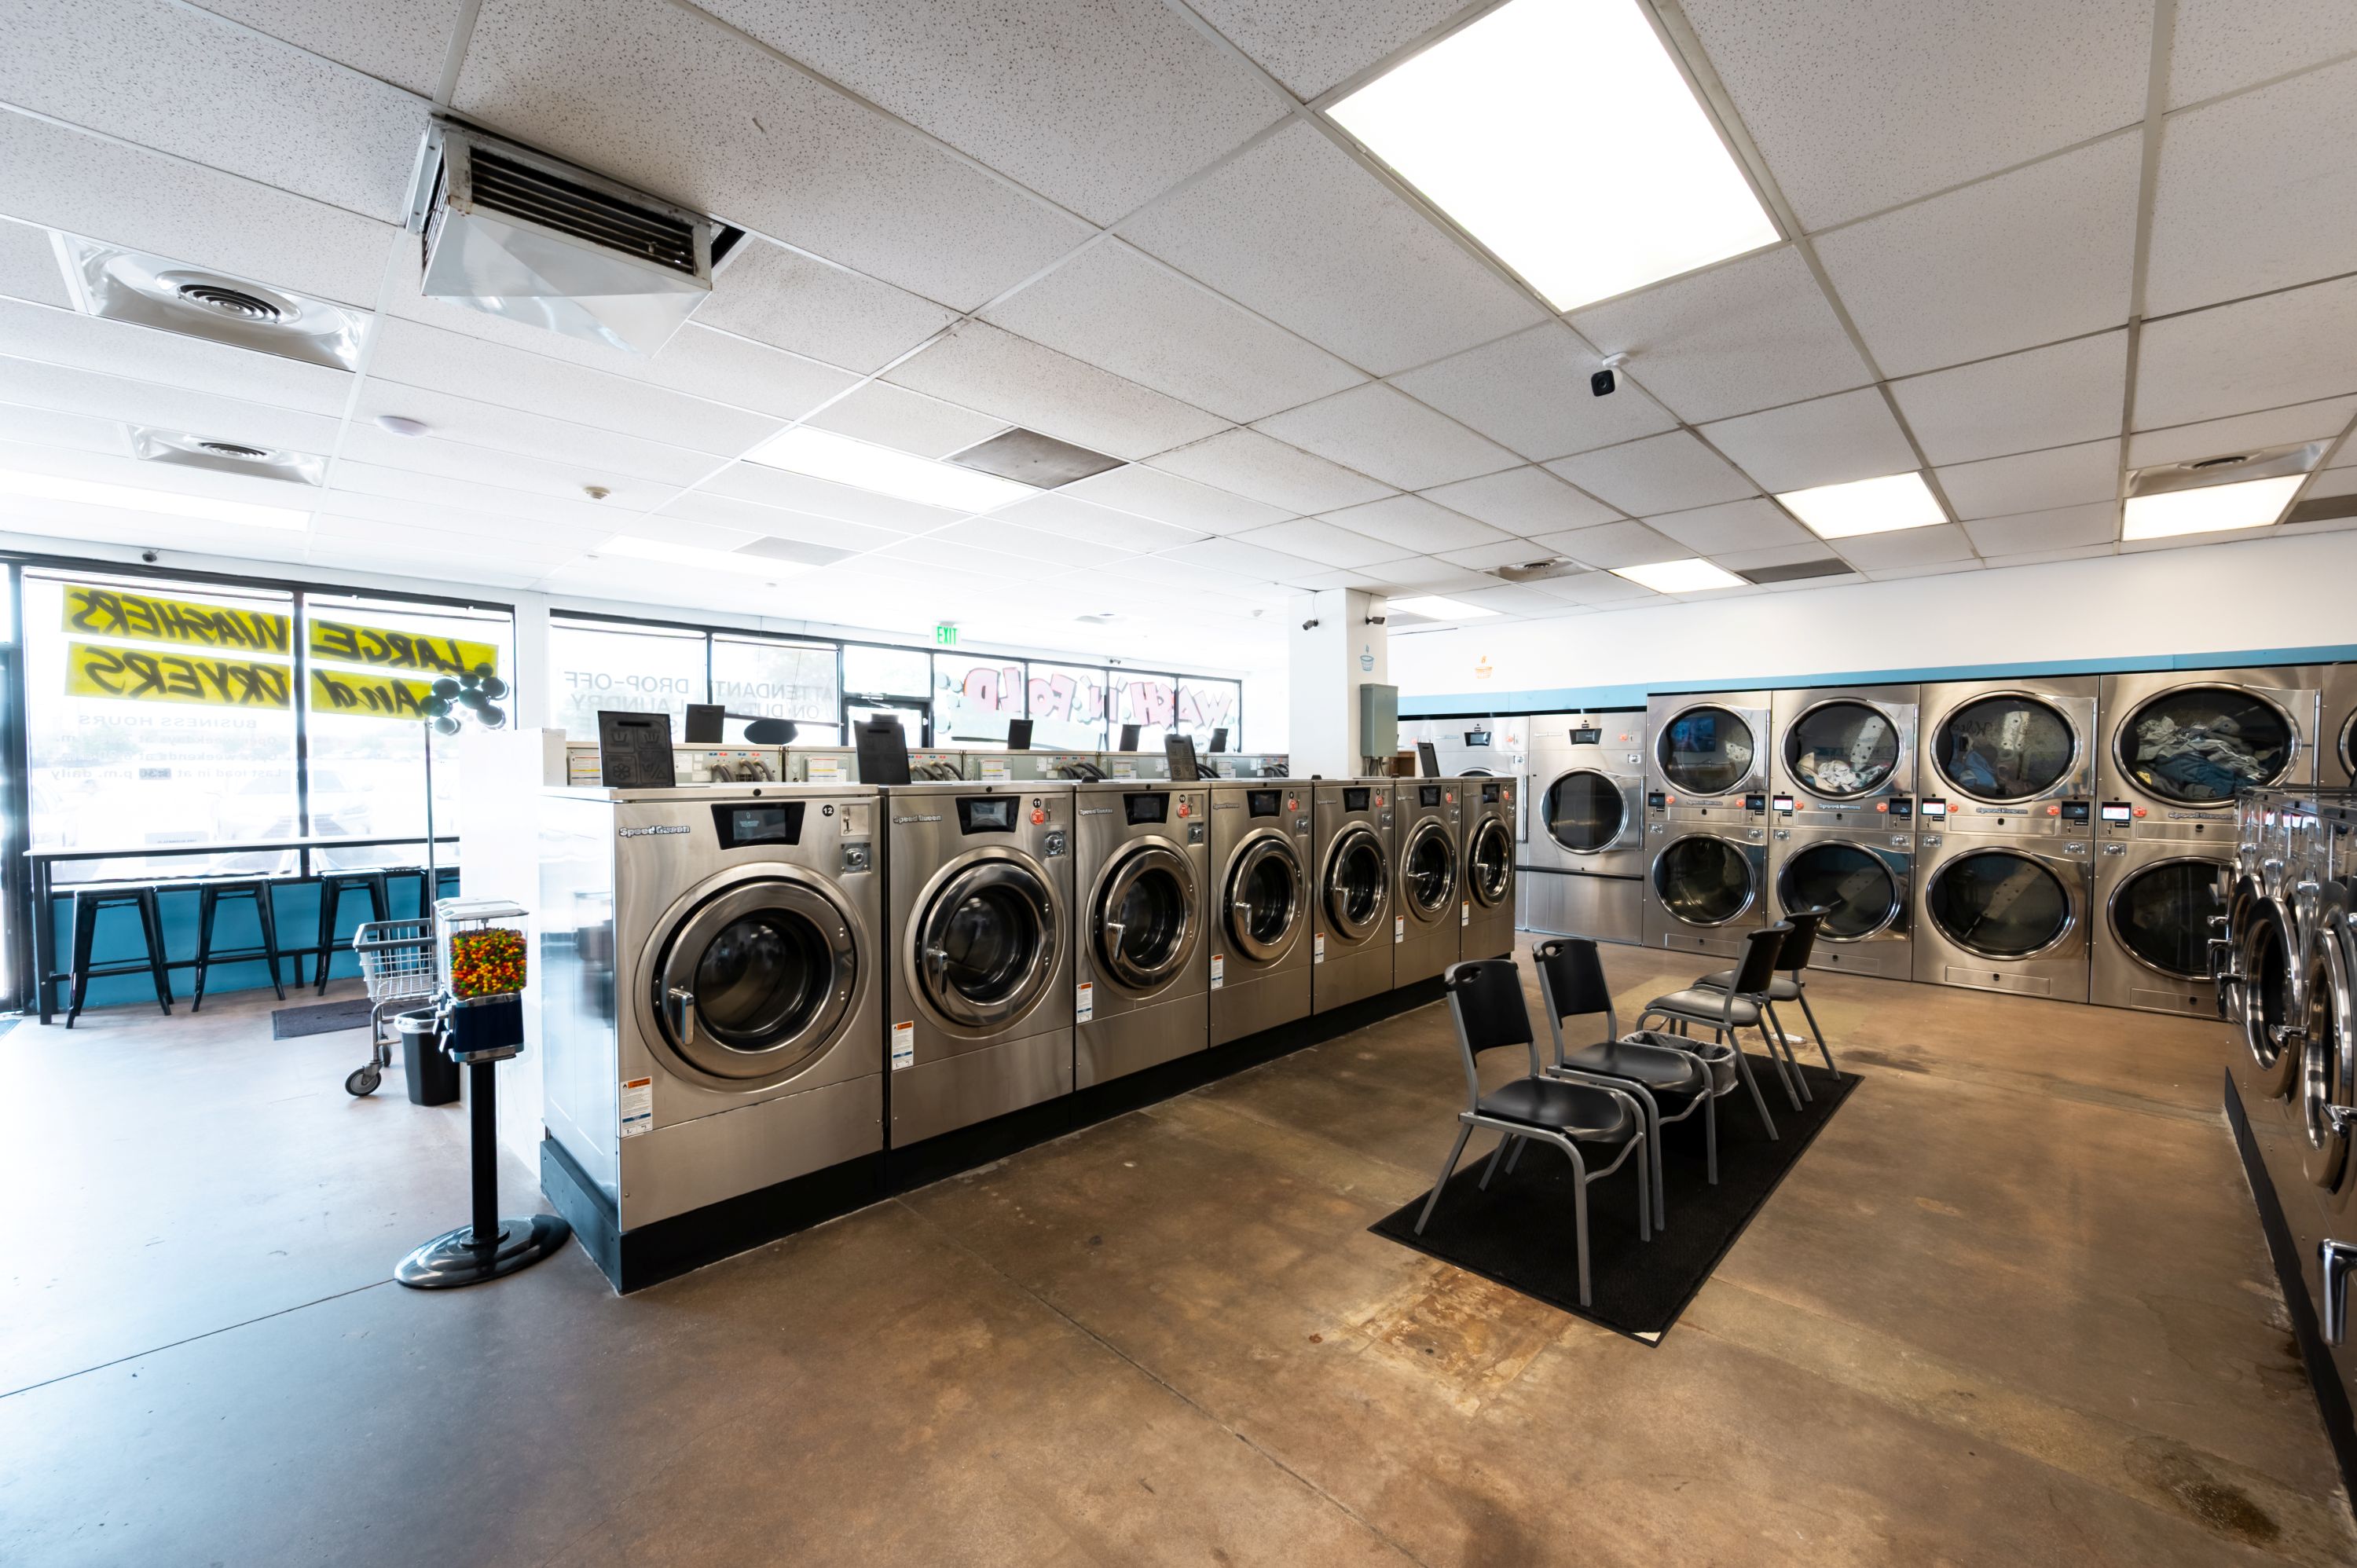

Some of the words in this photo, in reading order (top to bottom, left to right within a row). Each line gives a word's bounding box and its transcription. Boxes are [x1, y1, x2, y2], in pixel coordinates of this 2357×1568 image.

[937, 627, 958, 645] EXIT
[893, 815, 918, 824] Speed
[619, 826, 655, 837] Speed
[655, 826, 690, 834] Queen
